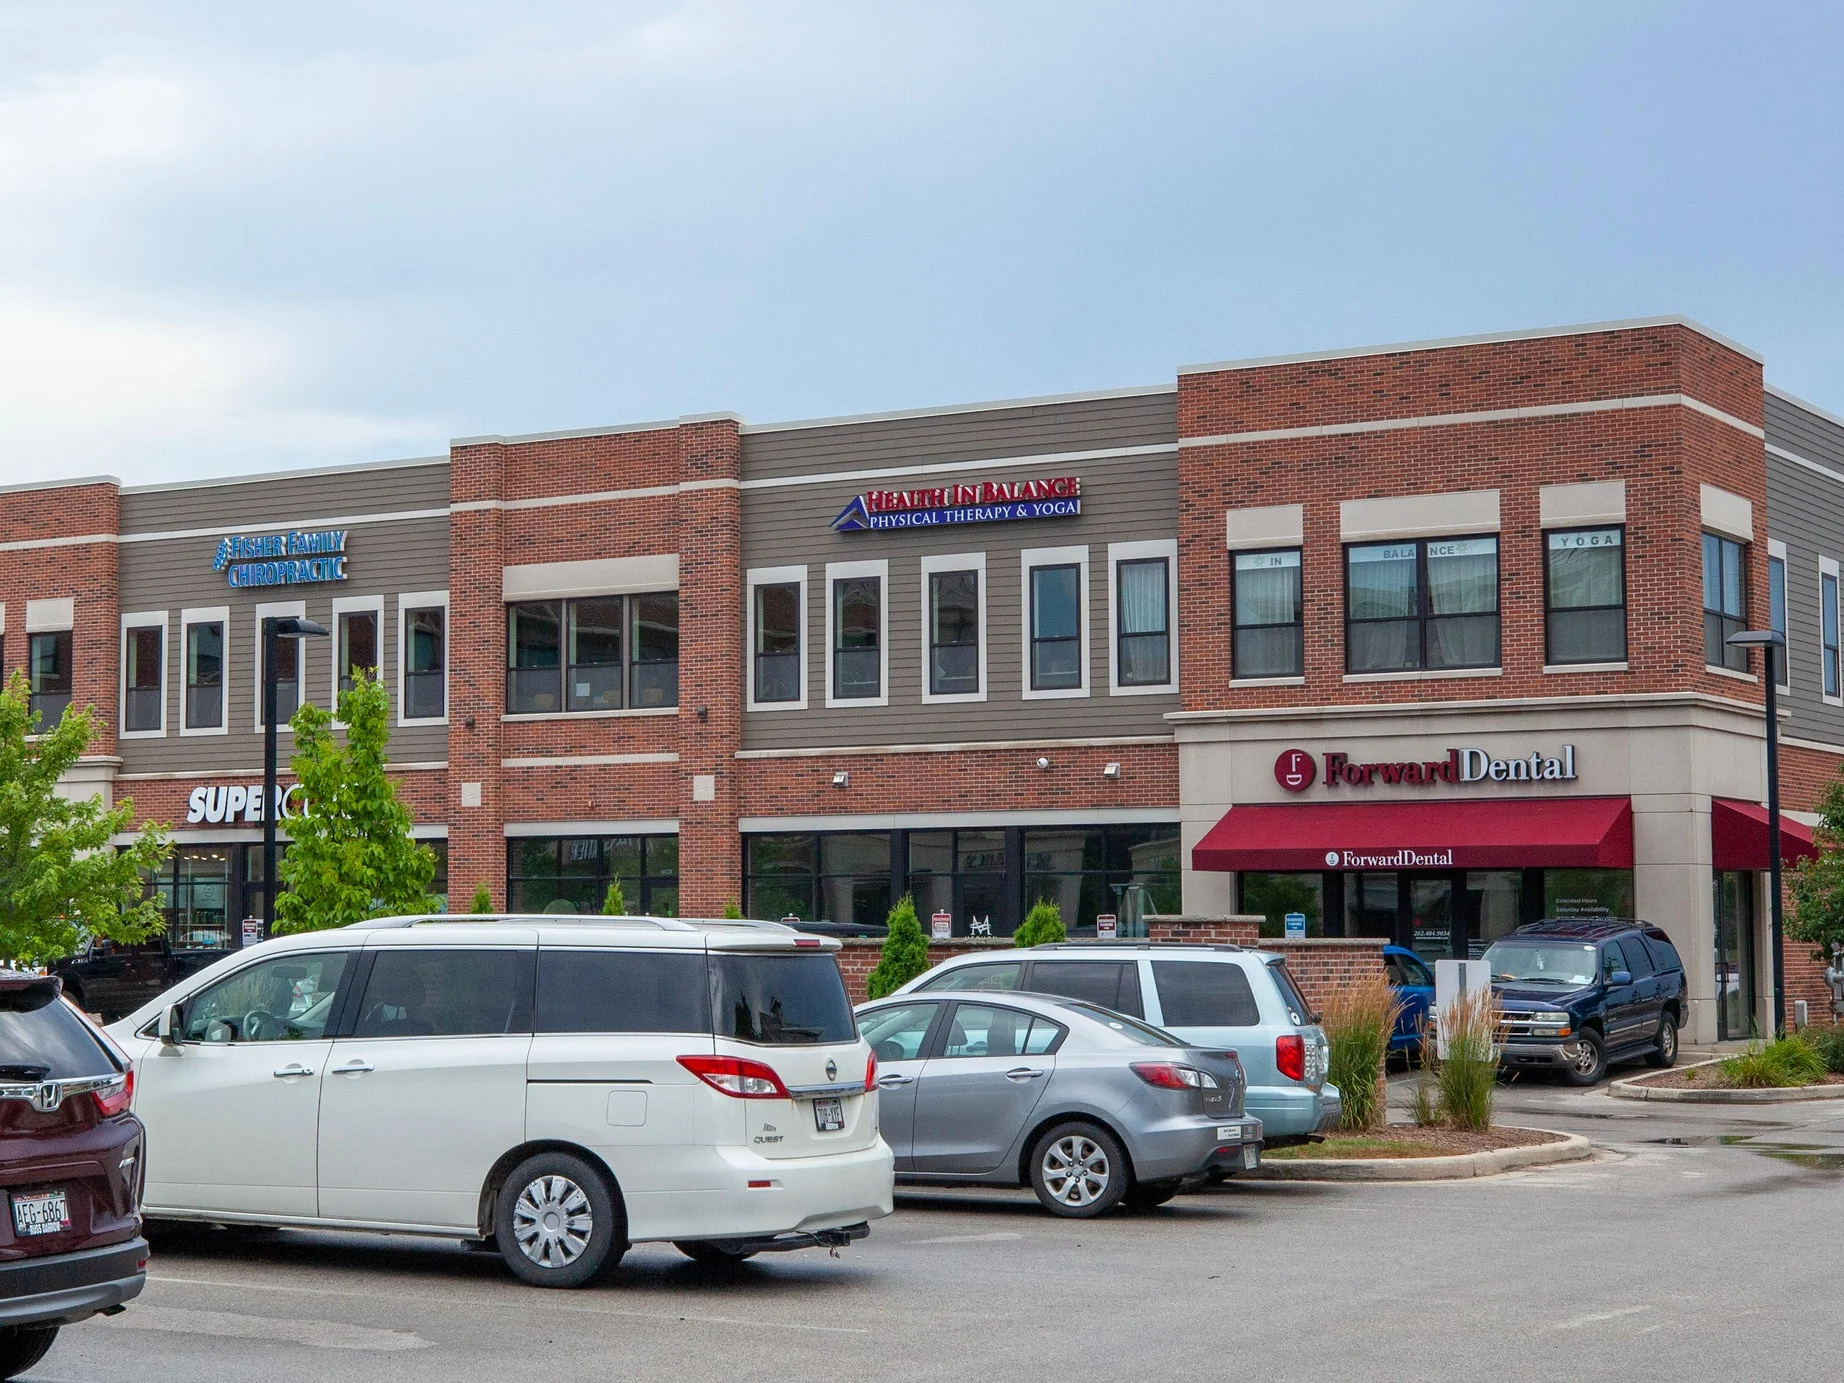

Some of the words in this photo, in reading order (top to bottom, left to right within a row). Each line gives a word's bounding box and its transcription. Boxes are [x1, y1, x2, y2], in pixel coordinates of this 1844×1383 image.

[867, 487, 950, 512] HEALTH
[952, 483, 982, 505] IN
[982, 477, 1081, 503] BALANCE
[869, 512, 940, 529] PHYSICAL
[944, 507, 1012, 523] THERAPY
[1016, 505, 1029, 517] &
[1032, 501, 1077, 516] YOGA
[230, 535, 287, 559] FISHER
[287, 529, 348, 555] FAMILY
[1560, 535, 1614, 547] YOGA
[228, 556, 347, 588] CHIROPRACTIC
[1270, 556, 1283, 566] IN
[1322, 744, 1578, 787] ForwardDental
[1343, 849, 1453, 868] ForwardDental
[753, 1135, 784, 1144] QUEST
[17, 1199, 67, 1226] AEG-6867
